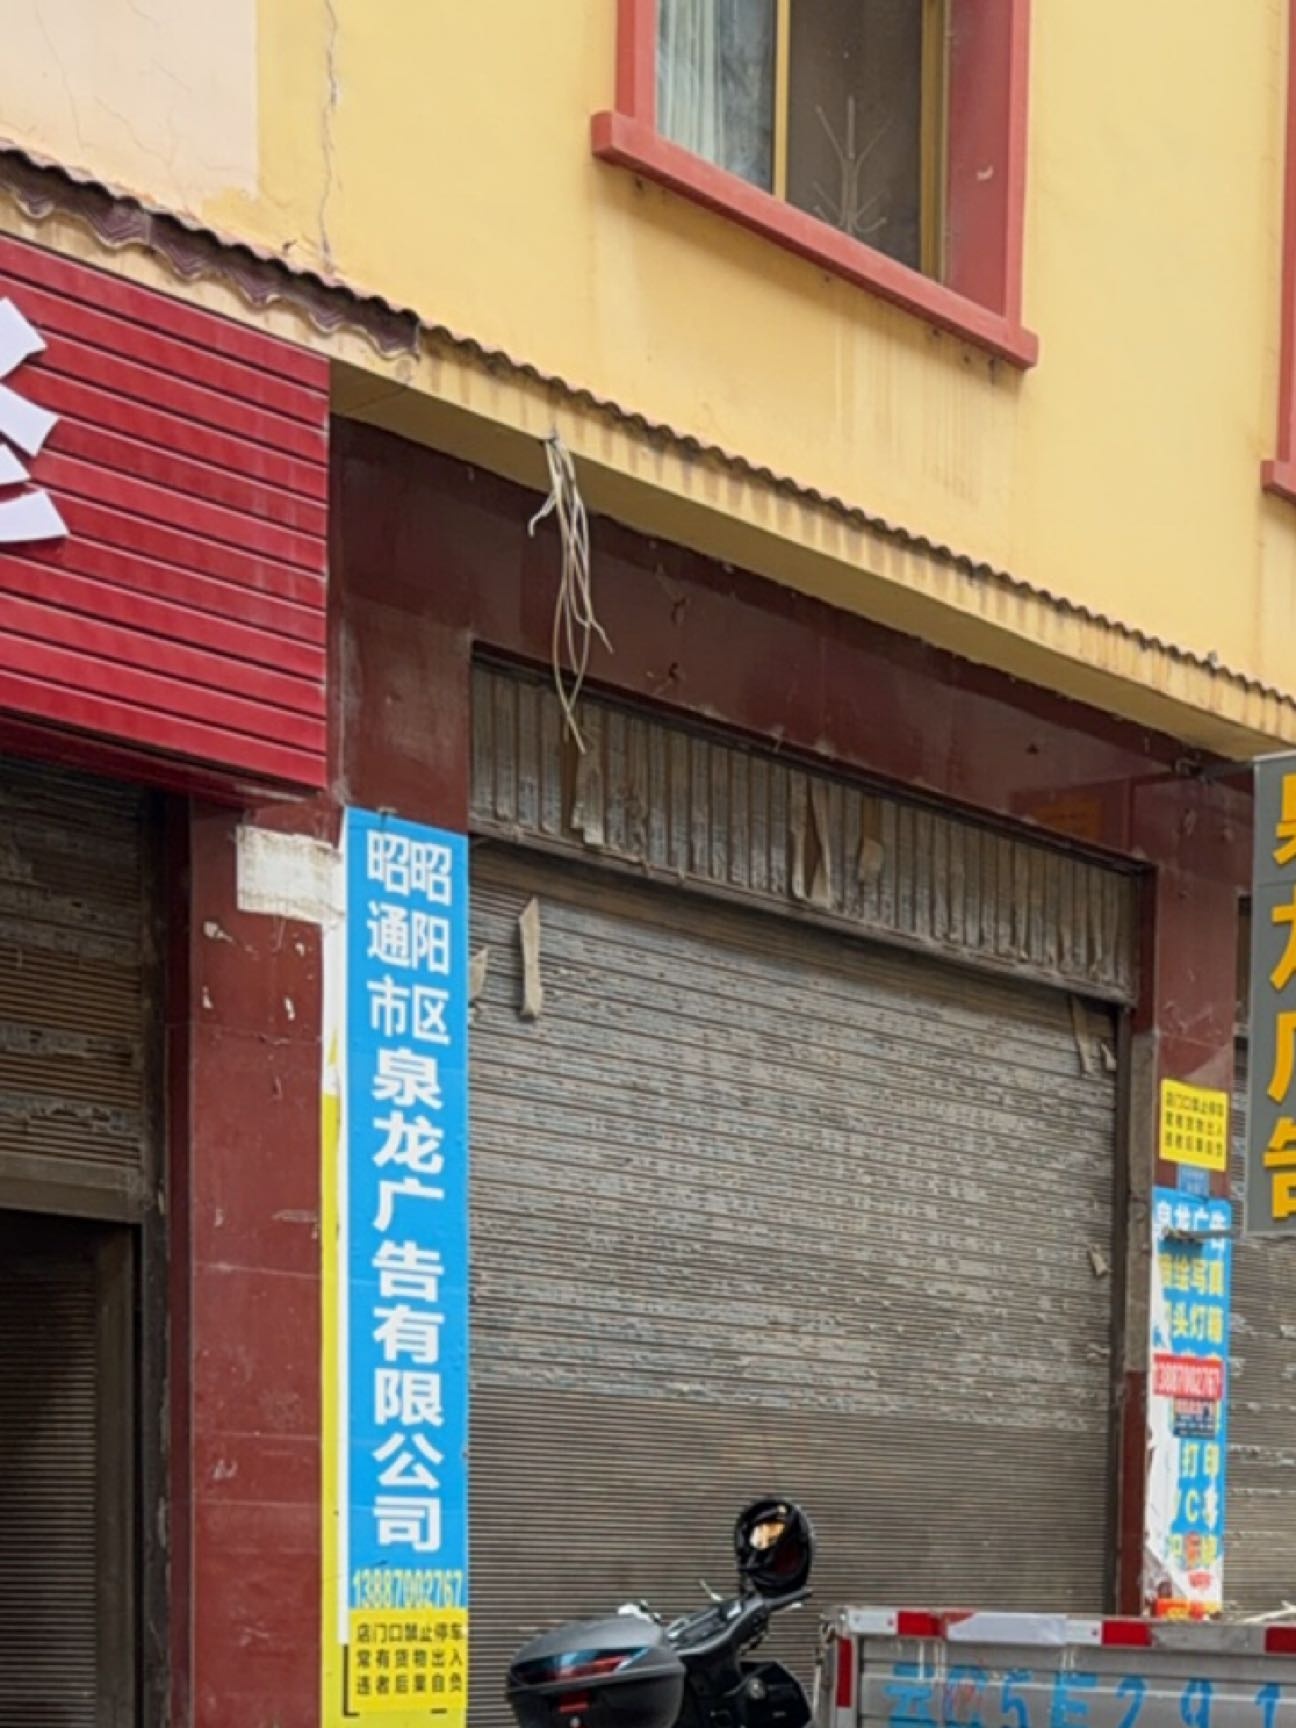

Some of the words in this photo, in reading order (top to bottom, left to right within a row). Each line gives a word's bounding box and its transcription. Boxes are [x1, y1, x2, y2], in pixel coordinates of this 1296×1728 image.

[366, 829, 410, 1038] 昭通市
[409, 841, 453, 1046] 昭阳区
[371, 1047, 445, 1553] 泉龙广告有限公司
